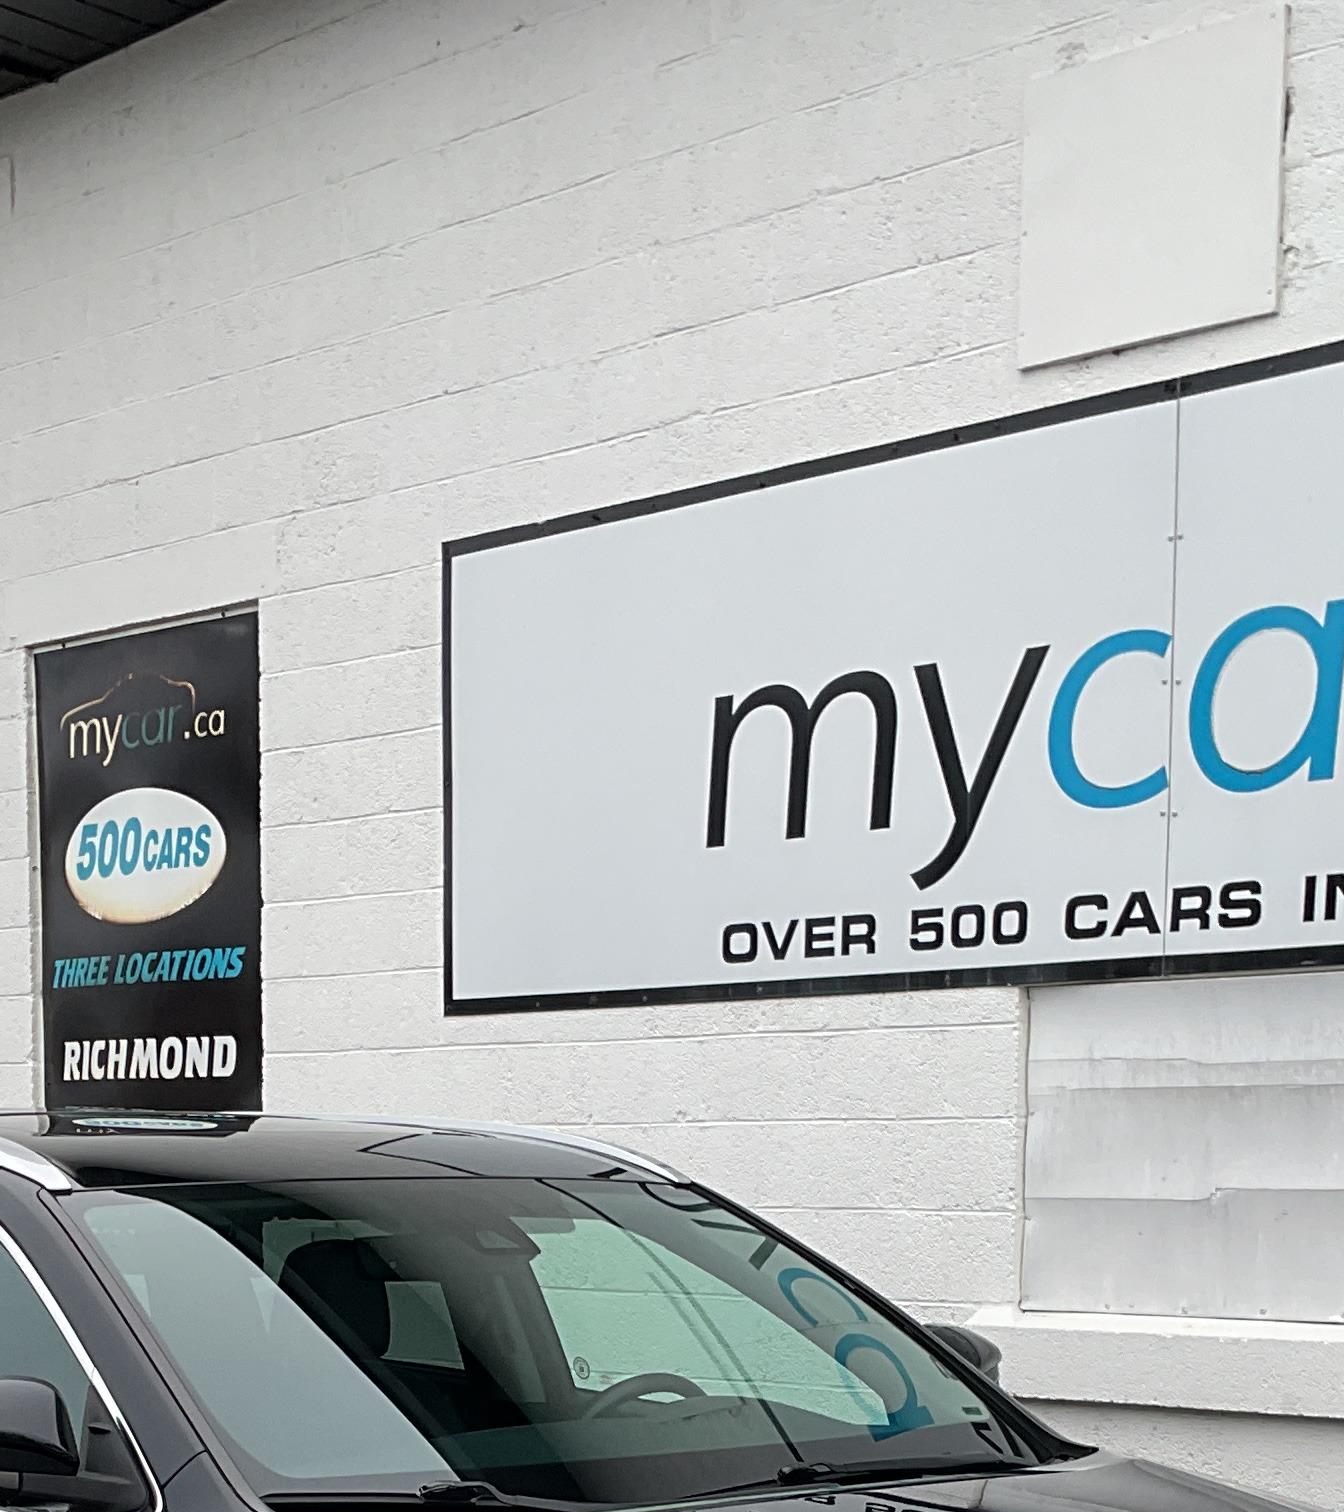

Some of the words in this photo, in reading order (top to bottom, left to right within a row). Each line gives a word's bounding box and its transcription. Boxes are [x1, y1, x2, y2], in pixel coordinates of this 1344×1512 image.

[68, 704, 226, 767] mycar.ca
[722, 914, 876, 965] OVER
[909, 900, 1029, 951] 500
[1064, 880, 1262, 940] CARS
[52, 954, 112, 989] THREE
[113, 945, 247, 985] LOCATIONS
[63, 1035, 237, 1081] RICHMOND
